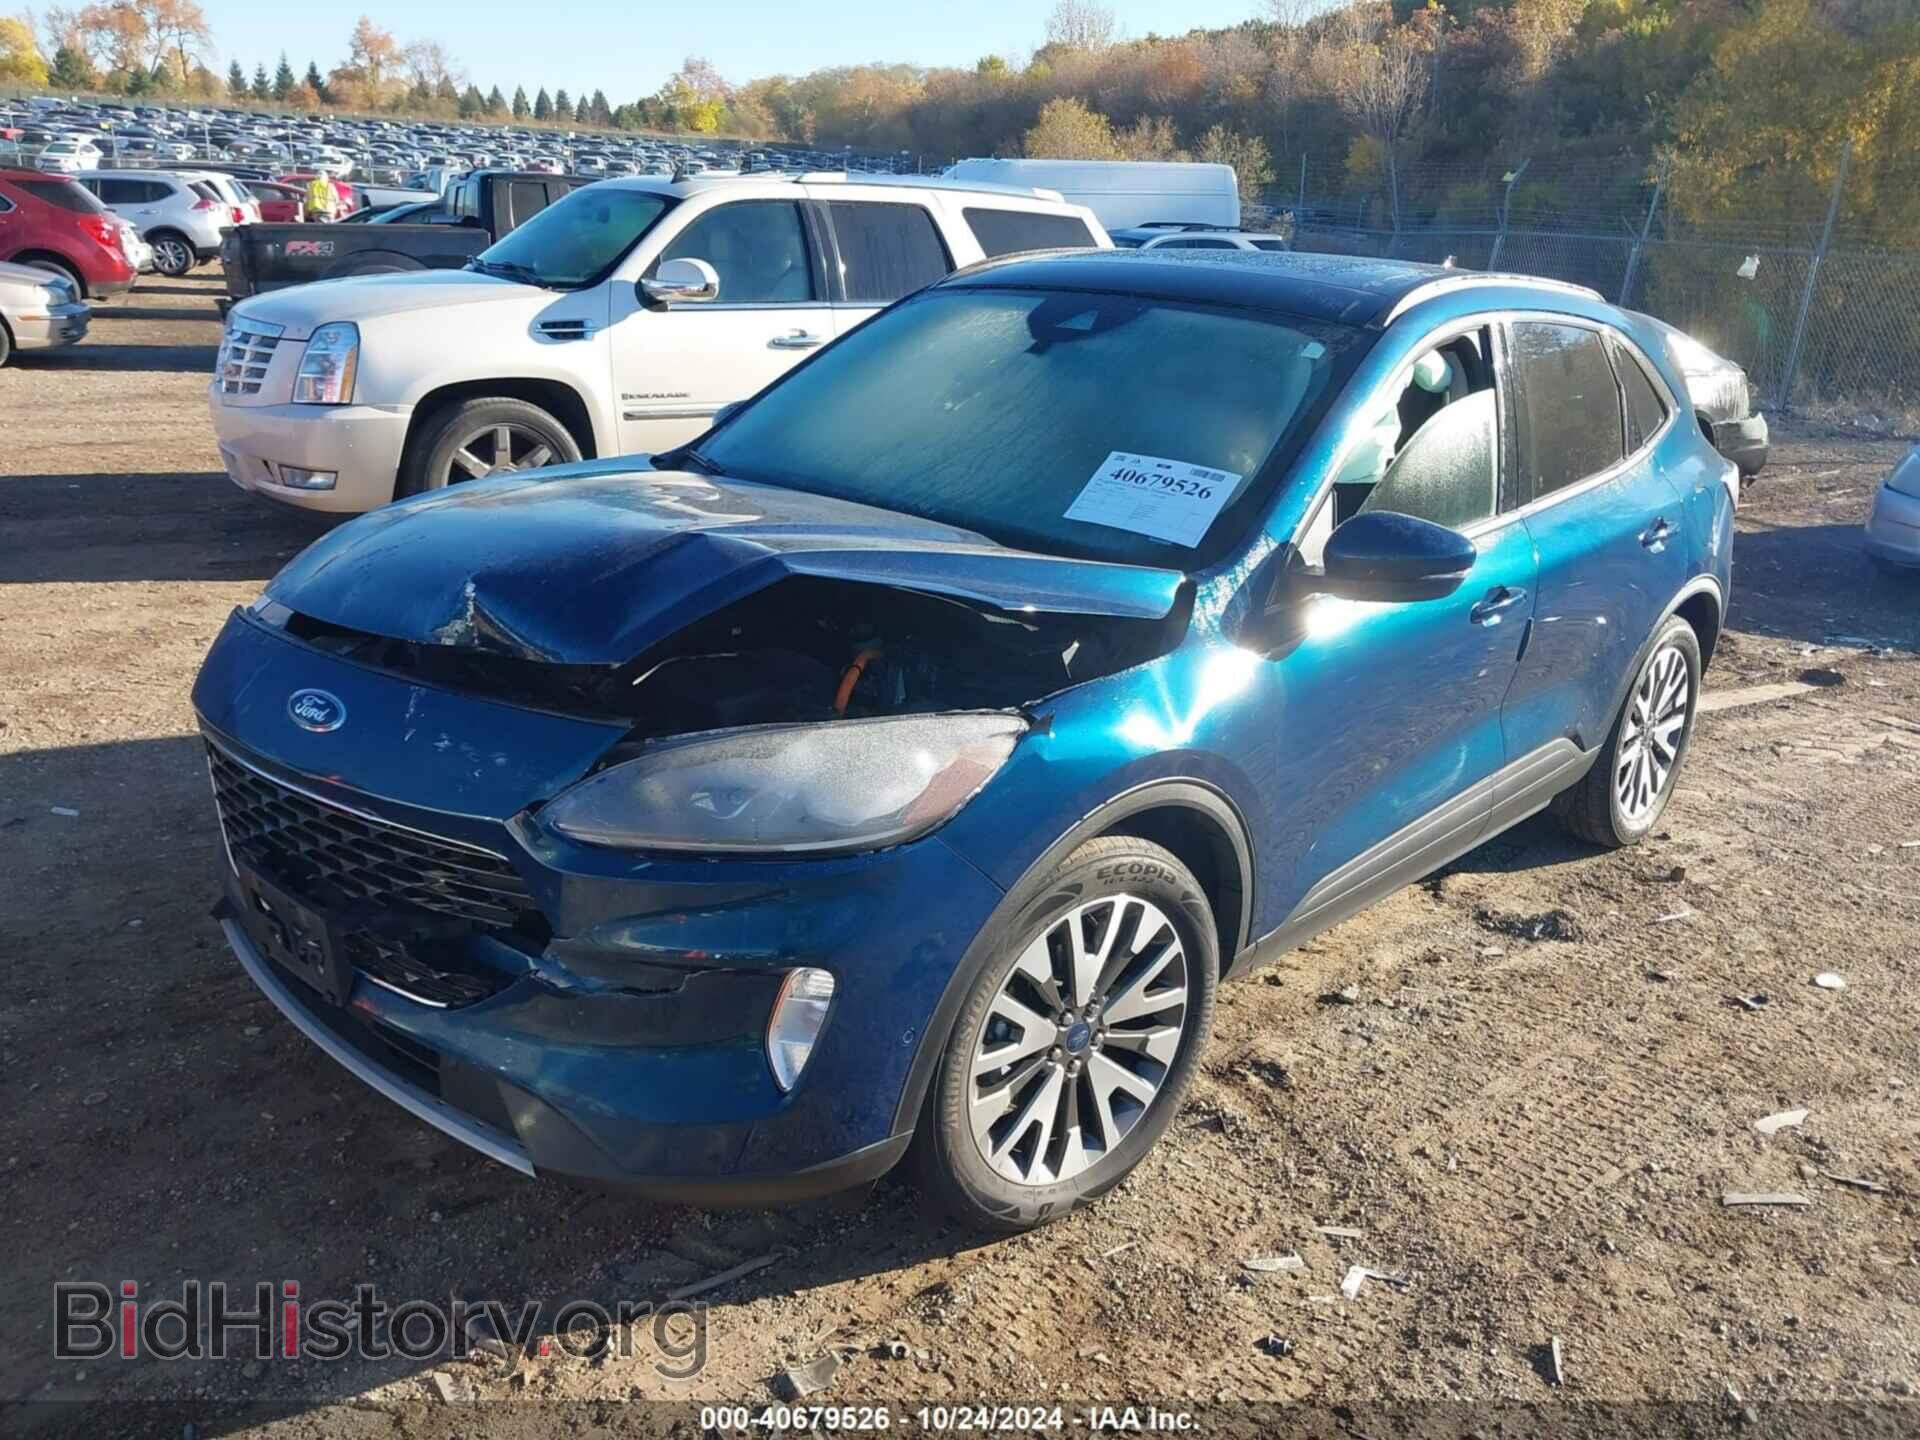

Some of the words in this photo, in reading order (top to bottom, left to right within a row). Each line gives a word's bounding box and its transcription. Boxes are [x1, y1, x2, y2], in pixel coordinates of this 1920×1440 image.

[285, 240, 335, 253] FX4
[1110, 467, 1214, 500] 40679526
[295, 695, 330, 721] Ford
